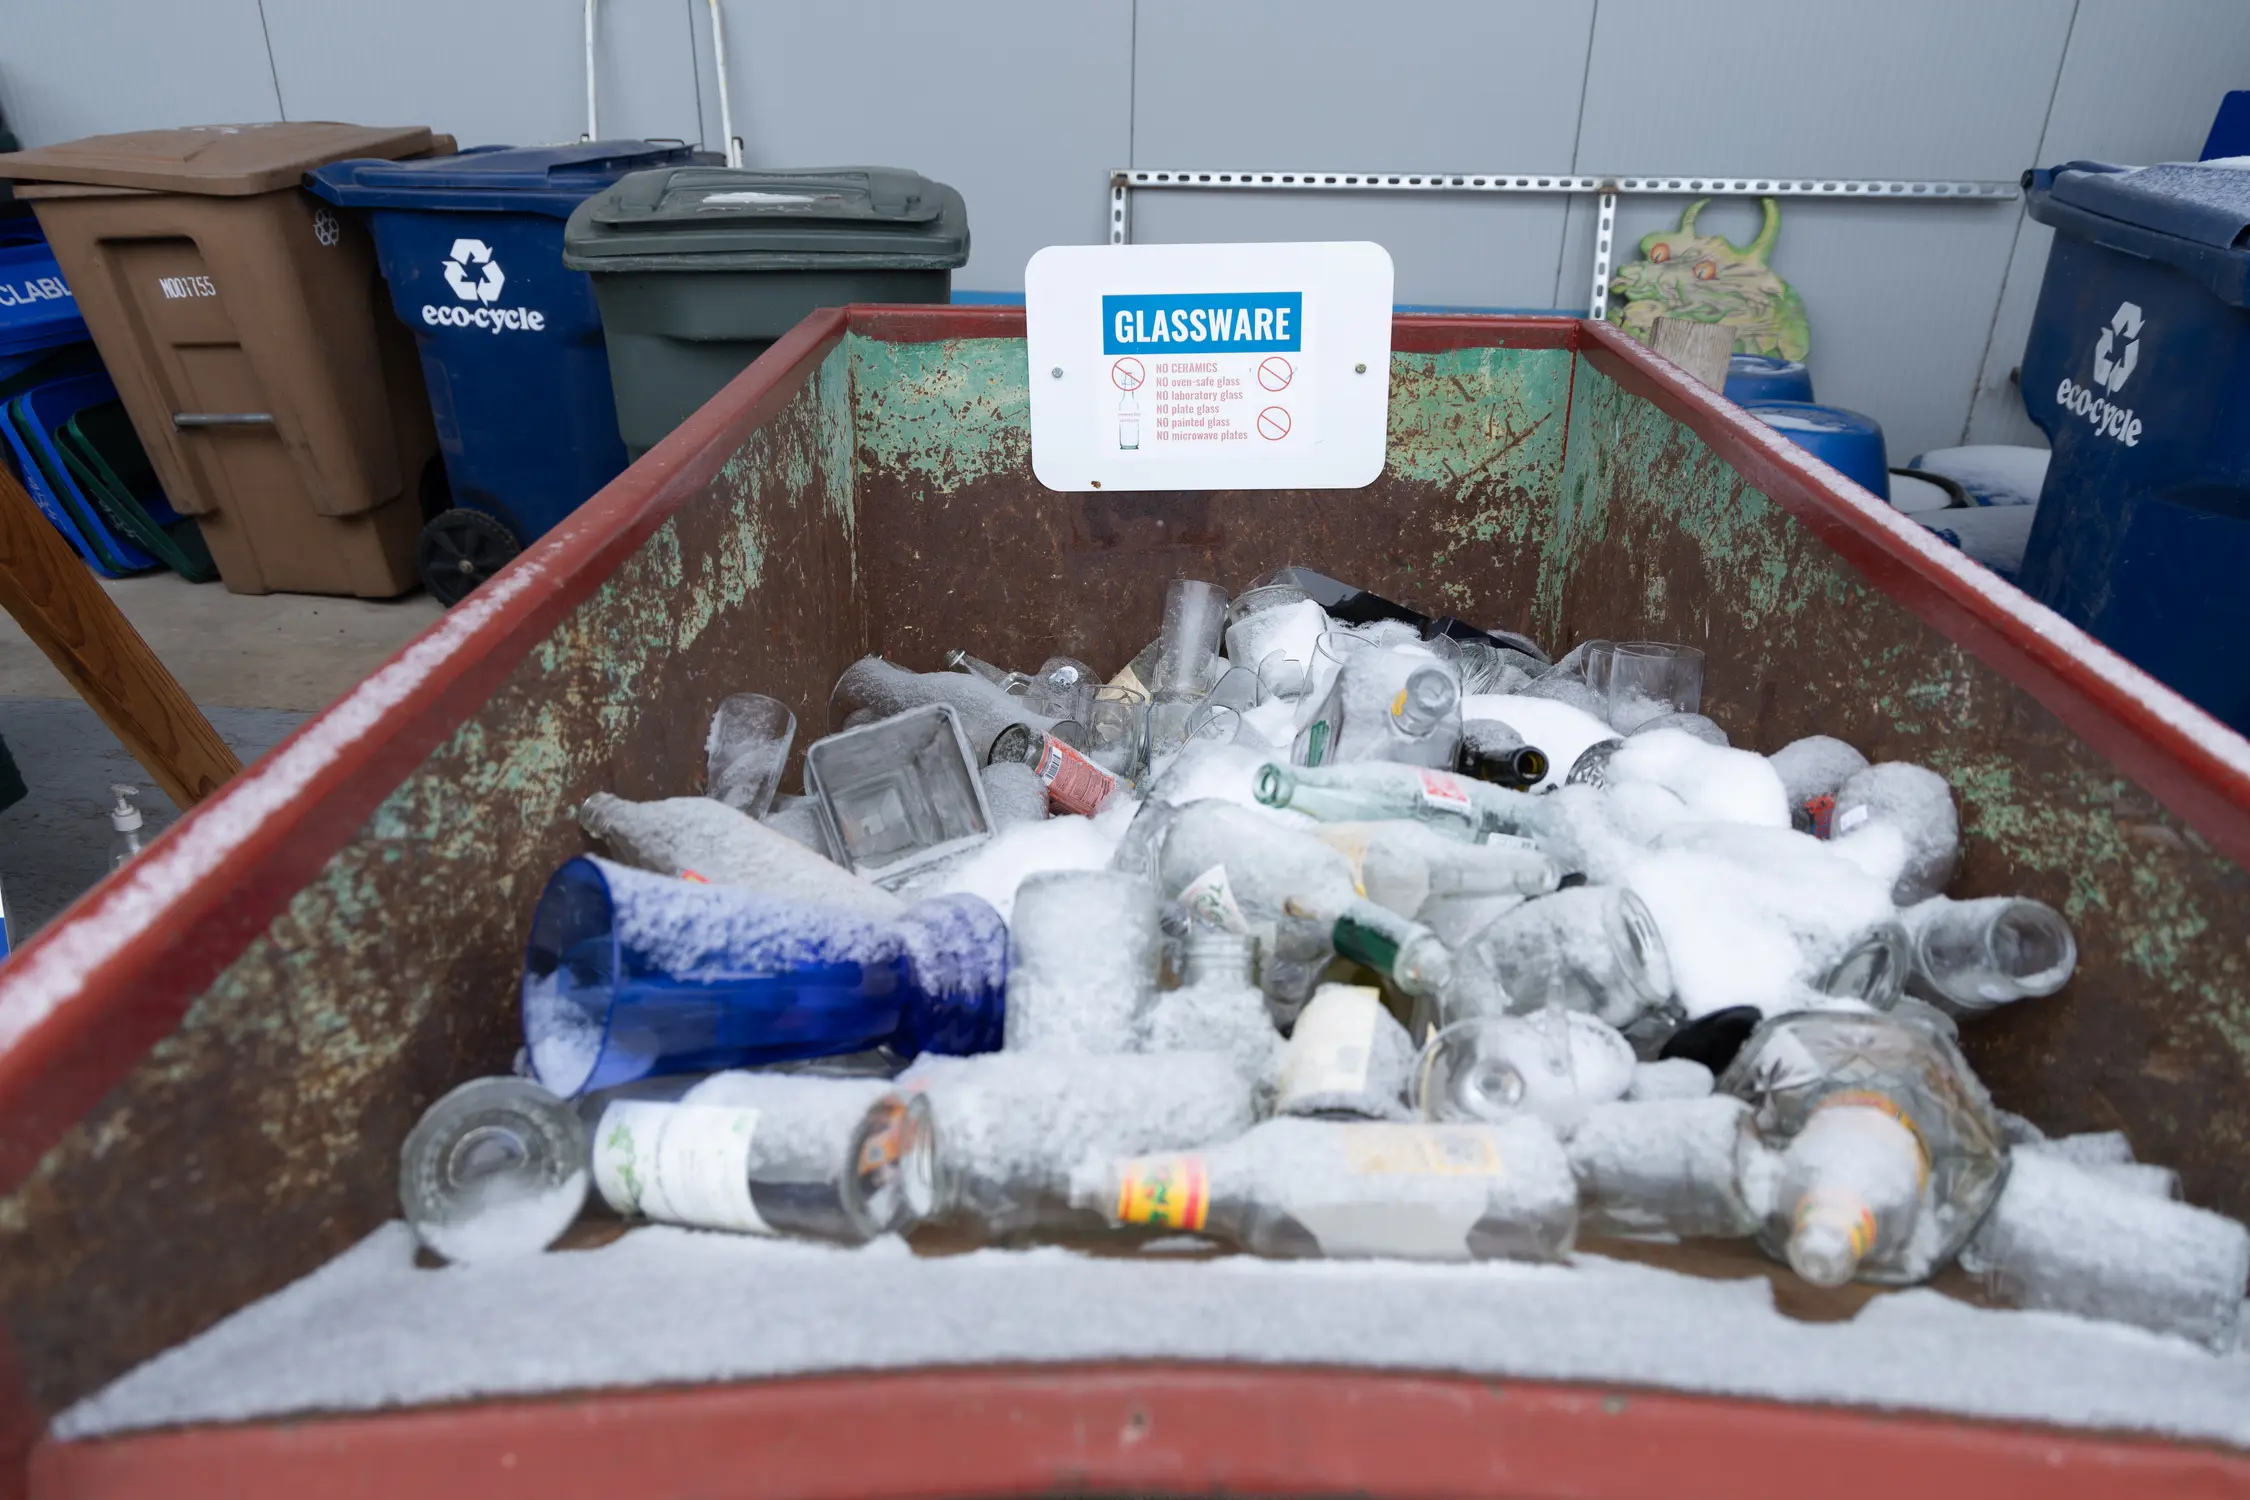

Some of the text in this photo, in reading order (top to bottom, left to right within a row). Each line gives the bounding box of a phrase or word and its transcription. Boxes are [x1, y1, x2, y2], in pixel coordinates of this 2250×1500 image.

[1115, 307, 1291, 343] GLASSWARE
[1156, 362, 1218, 374] NO CERAMICS
[1156, 376, 1240, 388] NO oven-safe glass
[1156, 390, 1243, 402] NO laboratory glass
[1156, 404, 1220, 416] NO plate glass
[1156, 417, 1230, 429] NO painted glass
[1156, 430, 1248, 442] NO microwave plates
